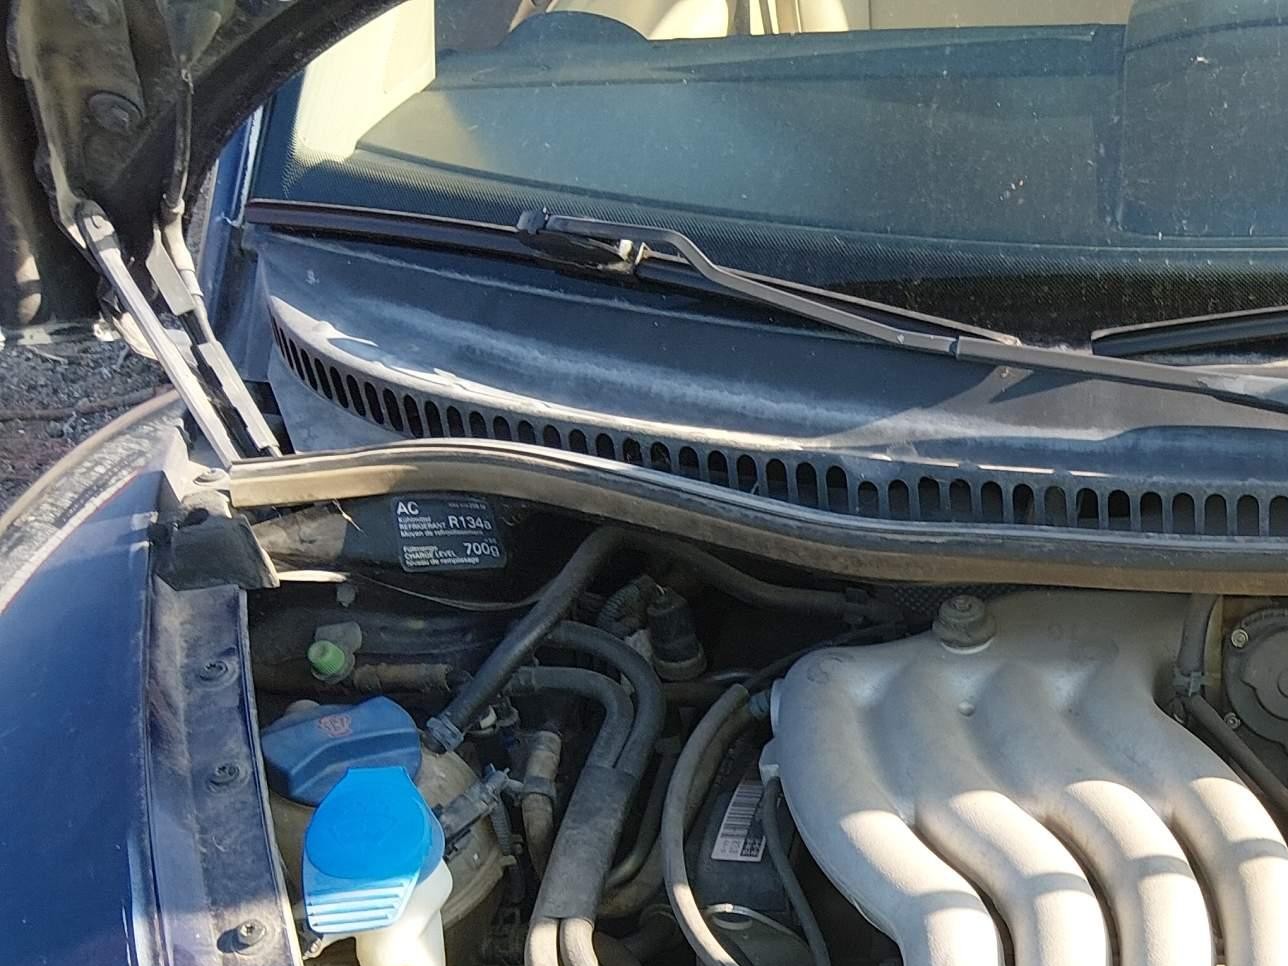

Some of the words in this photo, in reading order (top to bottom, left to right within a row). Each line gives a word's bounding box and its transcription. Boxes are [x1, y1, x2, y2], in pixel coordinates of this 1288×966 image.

[397, 501, 419, 515] AC
[448, 515, 492, 530] R134a
[463, 542, 500, 557] 700g
